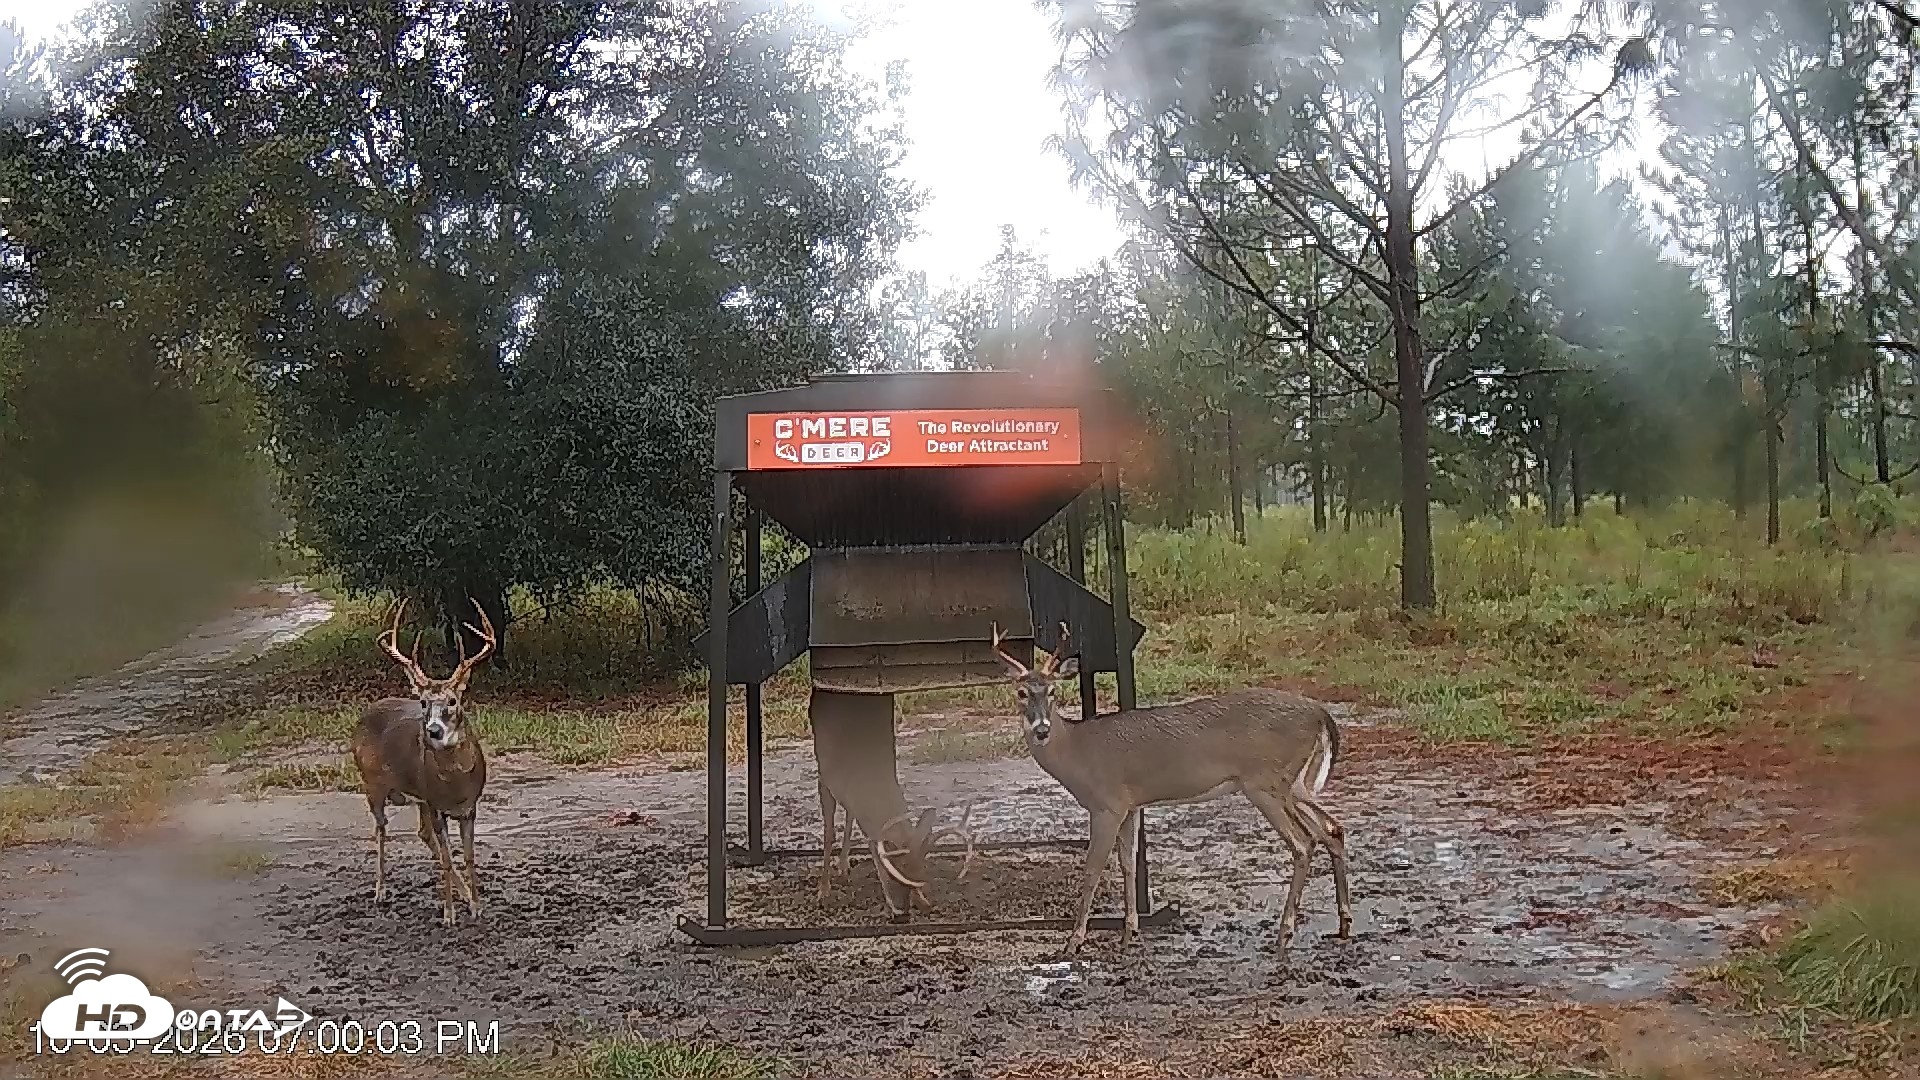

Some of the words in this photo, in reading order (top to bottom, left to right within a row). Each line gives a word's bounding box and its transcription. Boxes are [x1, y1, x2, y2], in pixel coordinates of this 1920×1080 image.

[775, 416, 891, 439] C'MERE
[918, 421, 947, 434] The
[951, 419, 1060, 435] Revolutionary
[806, 446, 860, 459] DEER
[927, 439, 965, 453] Deer
[969, 438, 1049, 453] Attractant
